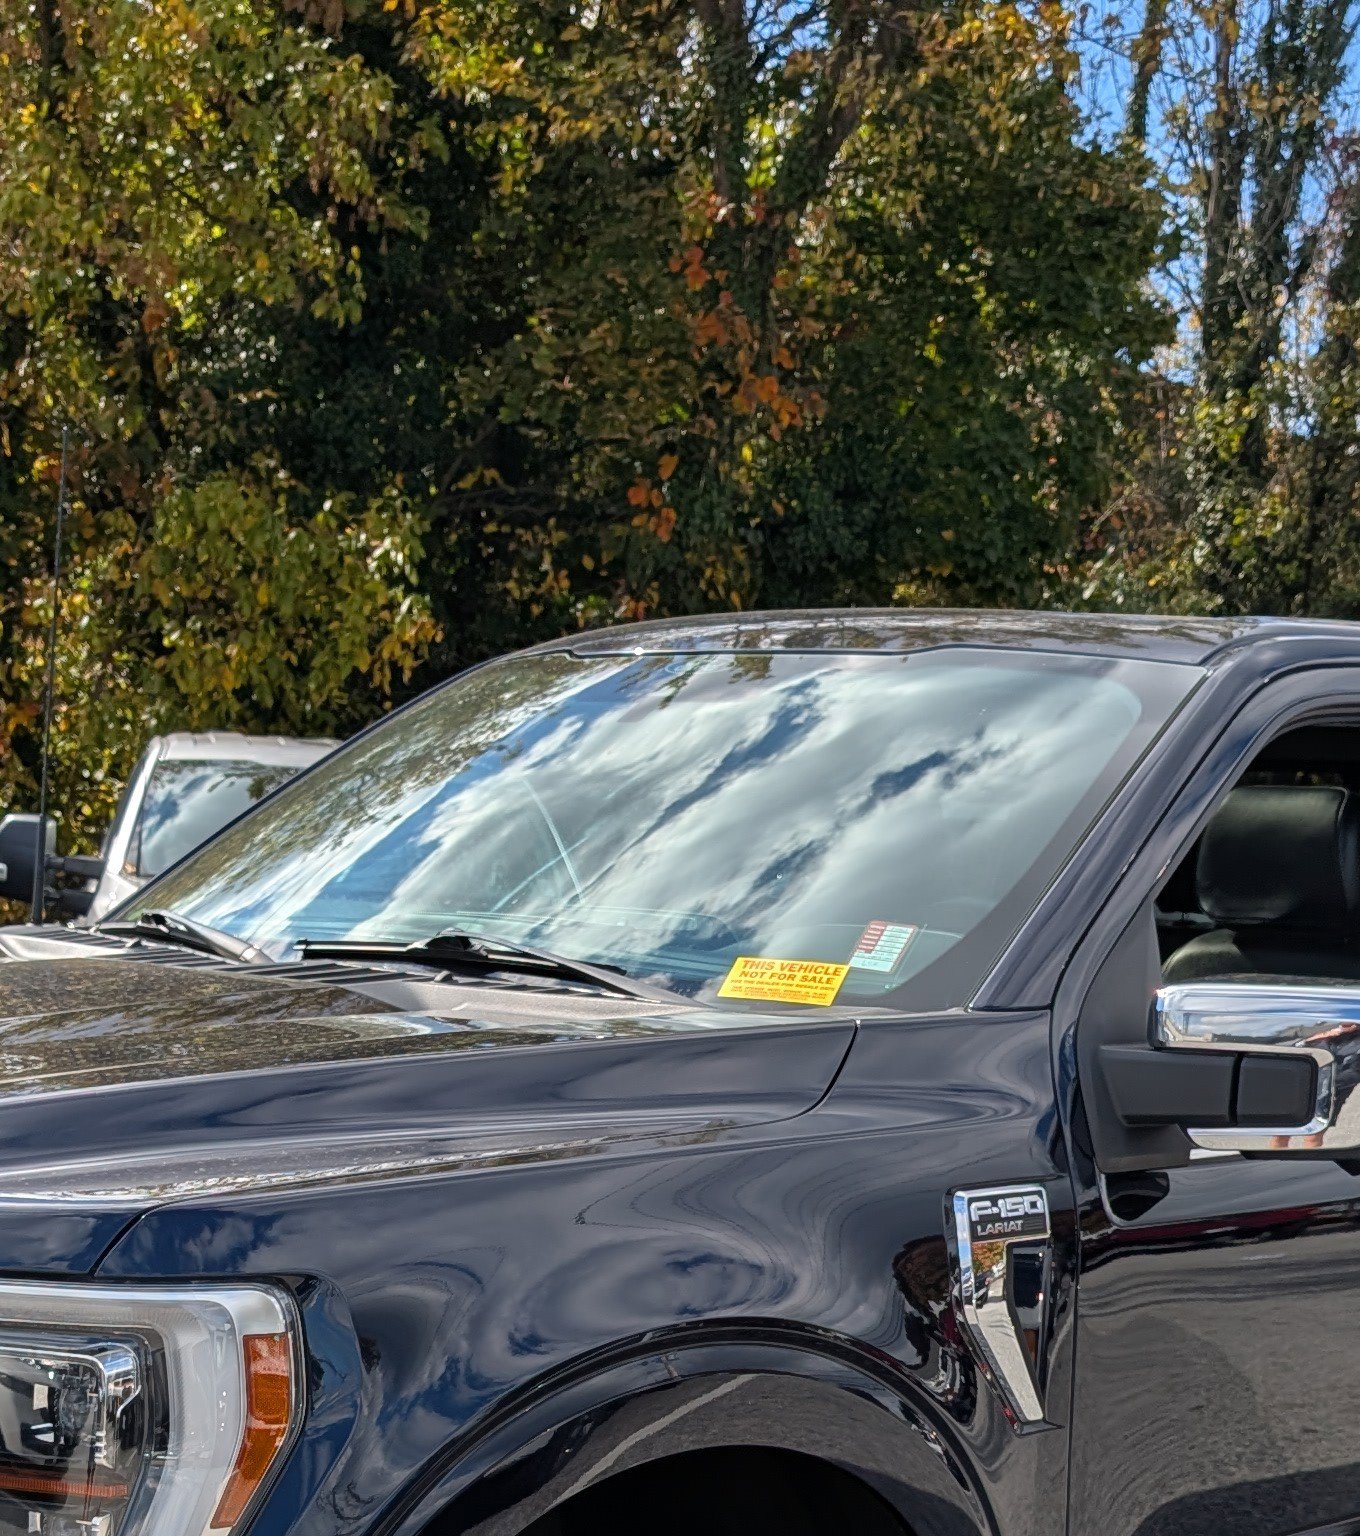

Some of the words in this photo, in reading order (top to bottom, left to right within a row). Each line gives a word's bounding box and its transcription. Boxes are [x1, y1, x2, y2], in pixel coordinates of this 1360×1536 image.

[741, 959, 776, 972] THIS
[779, 962, 845, 977] VEHICLE
[738, 970, 768, 980] NOT
[768, 973, 797, 982] FOR
[800, 975, 836, 985] SALE
[969, 1194, 1046, 1223] F-150
[976, 1219, 1024, 1237] LARIAT
